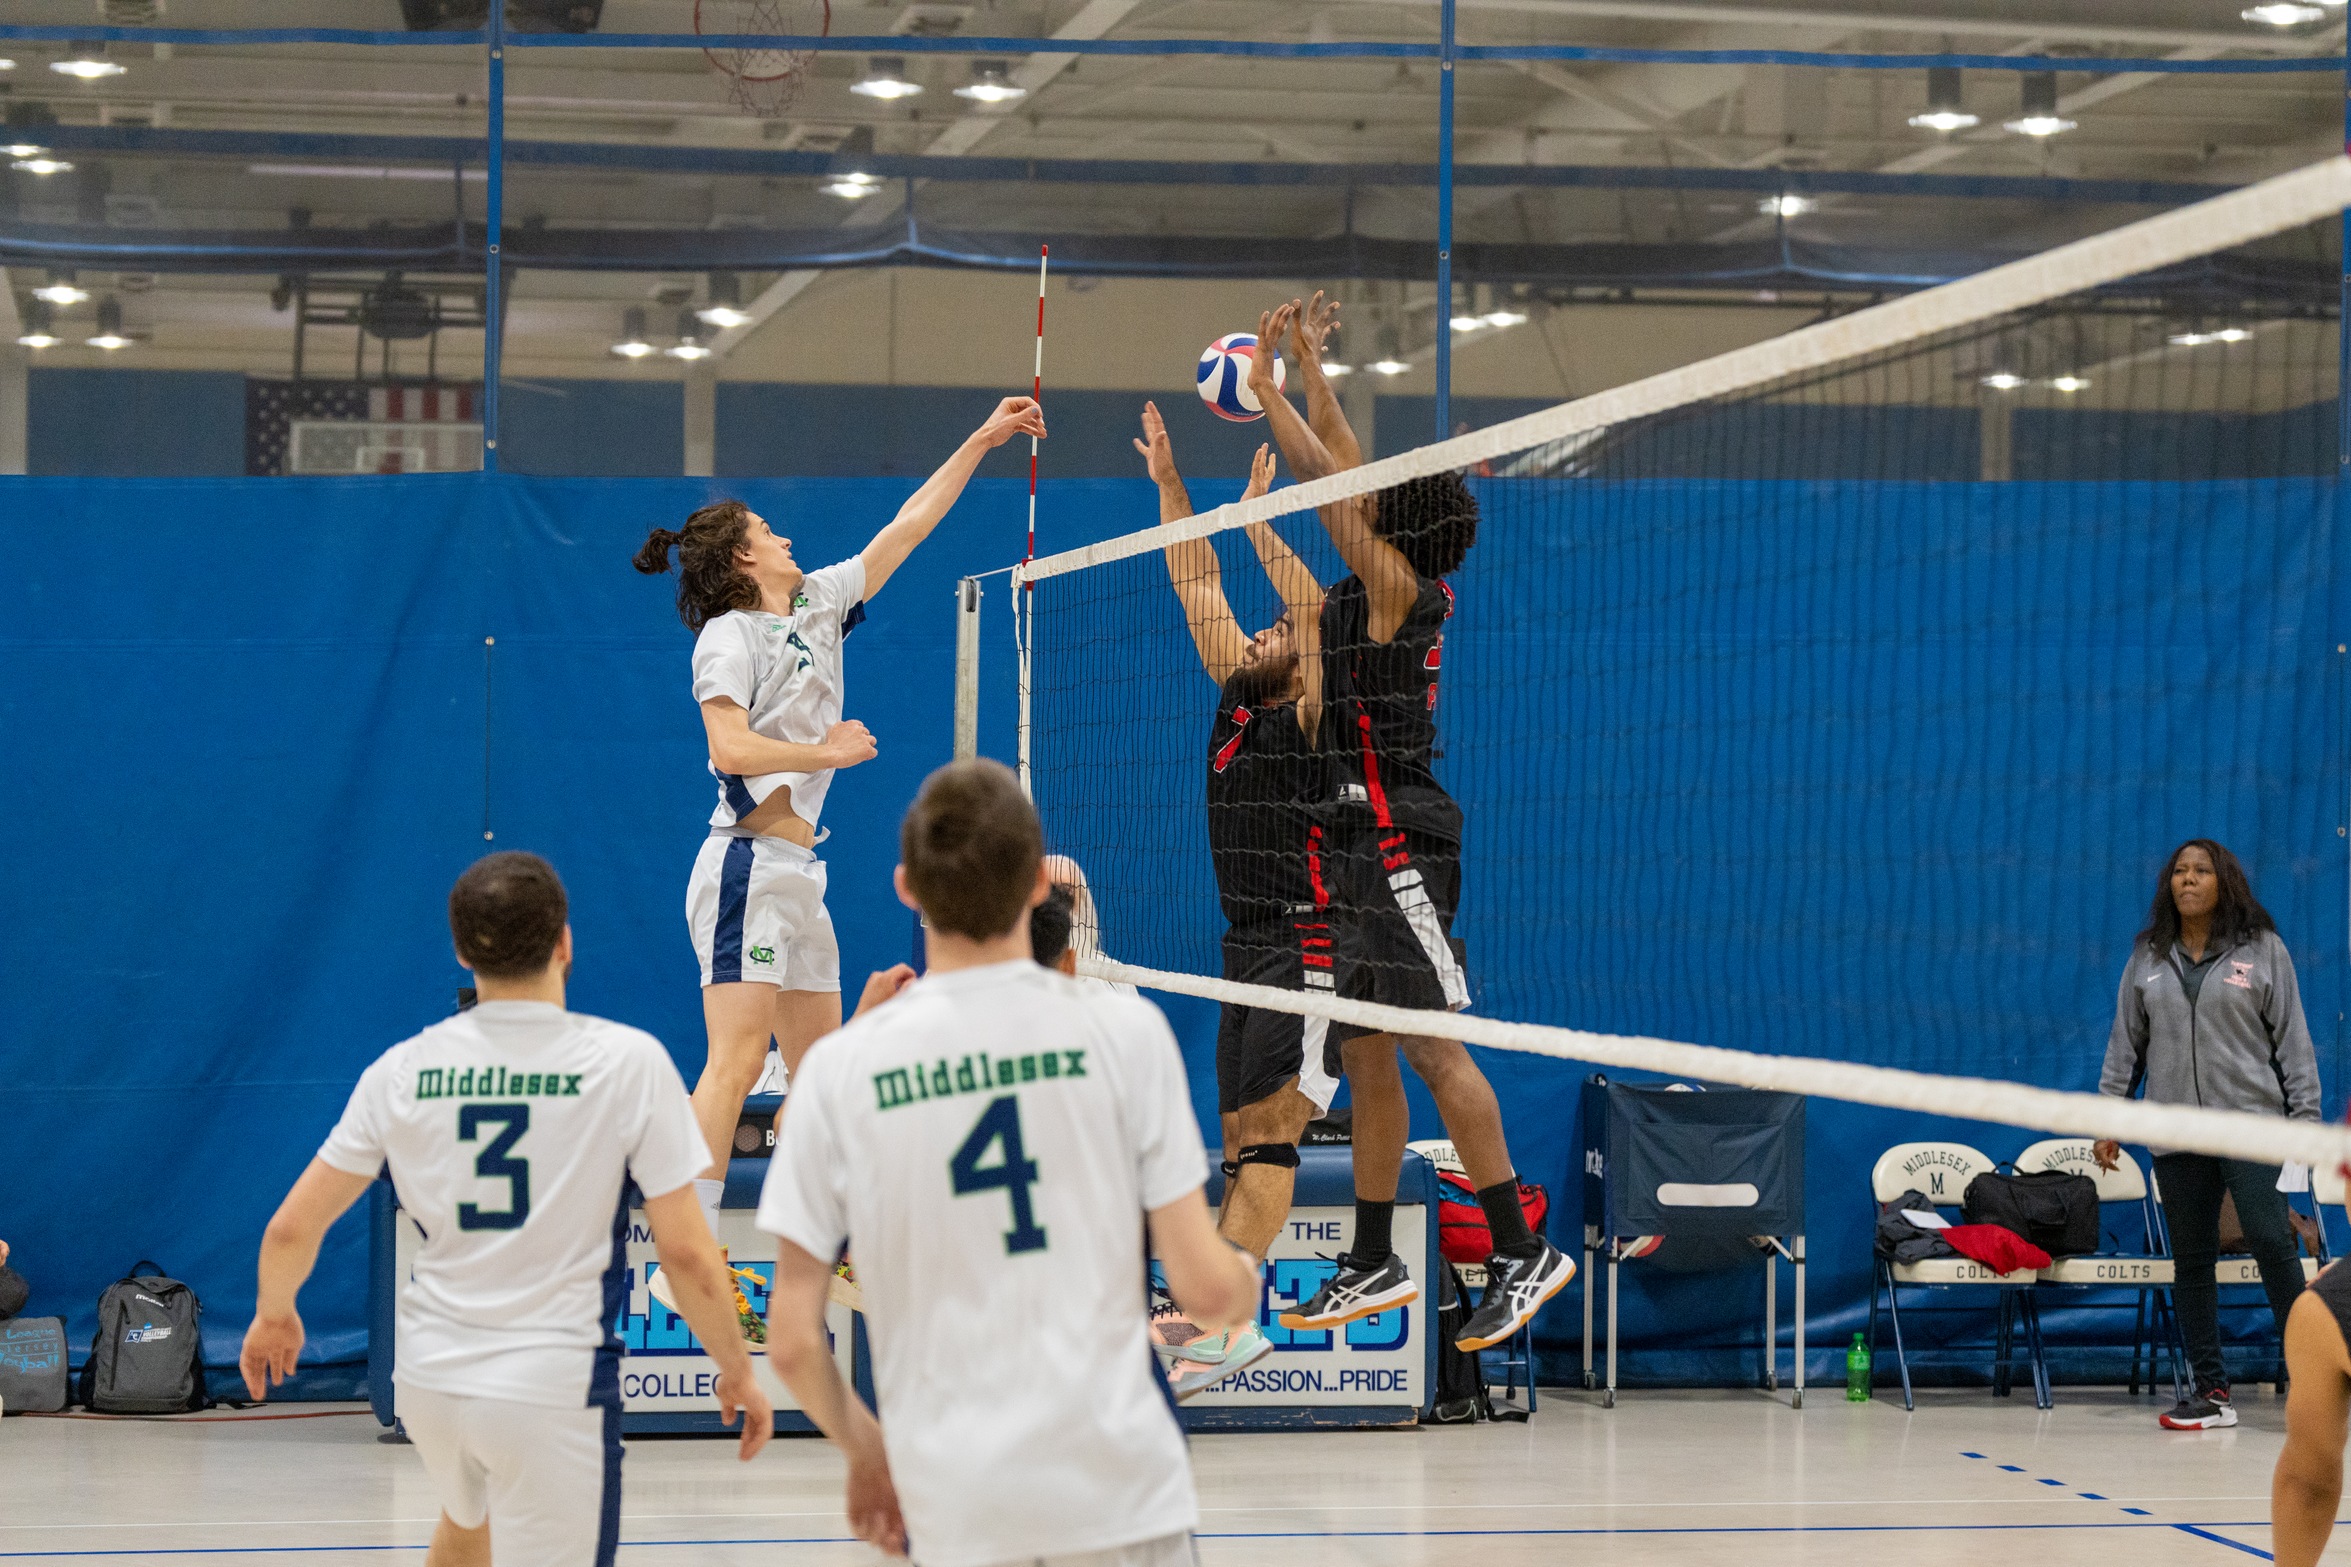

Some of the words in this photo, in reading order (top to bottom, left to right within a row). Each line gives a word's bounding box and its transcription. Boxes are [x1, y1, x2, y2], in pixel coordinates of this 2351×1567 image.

[416, 1066, 583, 1100] Middlesex
[874, 1049, 1087, 1111] Middlesex
[456, 1102, 531, 1232] 3
[1903, 1150, 1972, 1176] MIDDLESEX
[2042, 1146, 2100, 1169] MIDDLES
[947, 1093, 1048, 1257] 4
[1930, 1172, 1944, 1195] M
[1289, 1222, 1341, 1240] THE
[2097, 1264, 2151, 1279] COLTS
[624, 1372, 722, 1398] COLLE
